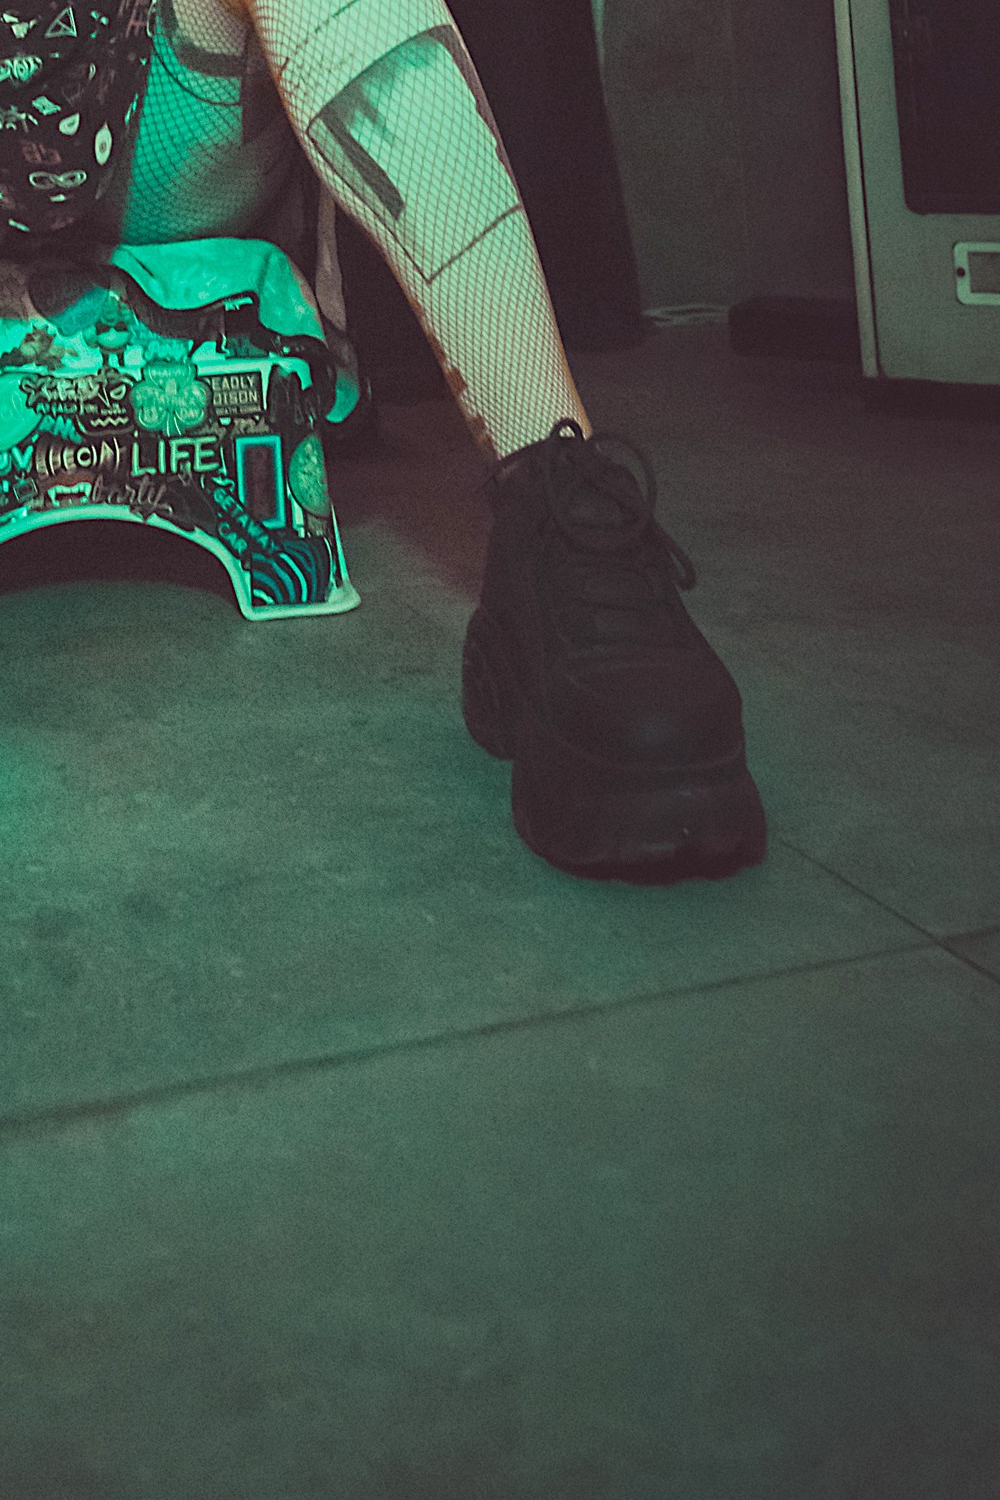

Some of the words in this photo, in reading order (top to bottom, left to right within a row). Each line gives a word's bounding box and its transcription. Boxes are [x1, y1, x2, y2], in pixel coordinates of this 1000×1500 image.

[212, 390, 259, 407] OISON
[130, 436, 220, 477] LIFE
[218, 521, 249, 555] CAR
